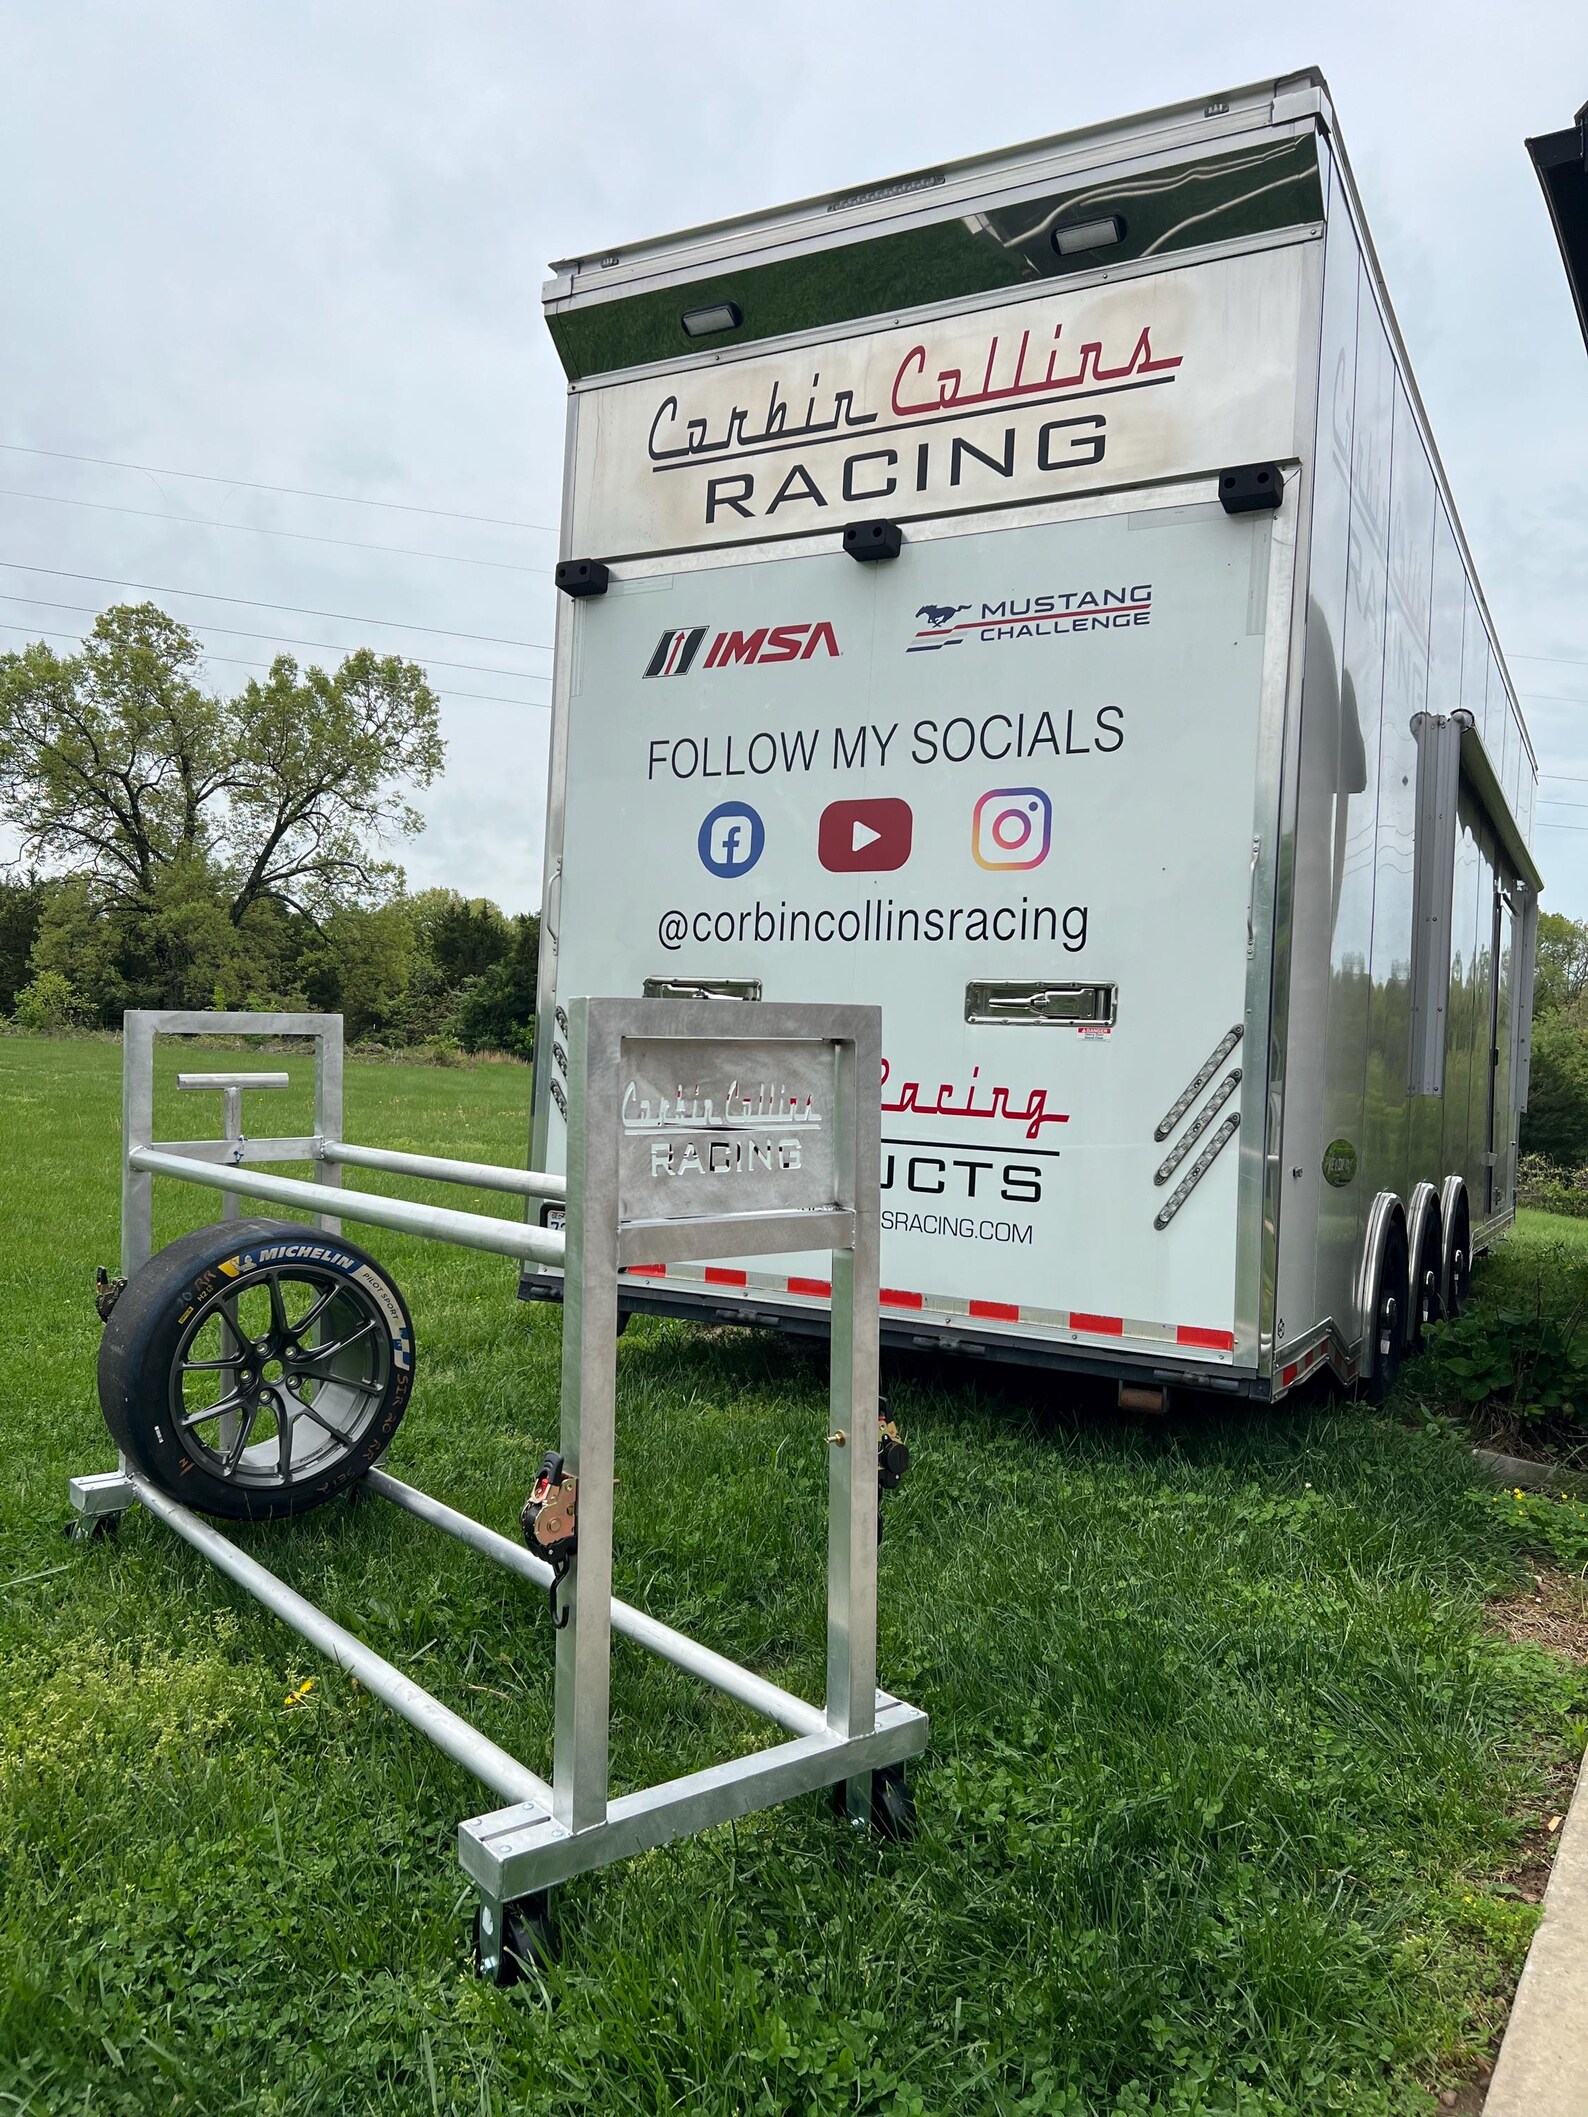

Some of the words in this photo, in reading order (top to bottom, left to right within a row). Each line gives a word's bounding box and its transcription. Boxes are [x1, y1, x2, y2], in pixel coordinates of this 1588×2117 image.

[648, 373, 878, 460] Corbin
[891, 324, 1184, 416] Collins
[705, 414, 1107, 524] RACING
[981, 584, 1152, 619] MUSTANG
[703, 621, 840, 669] IMSA
[980, 611, 1151, 641] CHALLENGE
[648, 728, 820, 780] FOLLOW
[833, 723, 899, 770] MY
[911, 705, 1125, 765] SOCIALS
[658, 896, 1089, 952] @corbincollinsracing
[651, 1138, 802, 1177] RACING
[259, 1245, 354, 1269] MICHELIN
[362, 1272, 383, 1294] PILOT
[381, 1293, 399, 1320] SPORT
